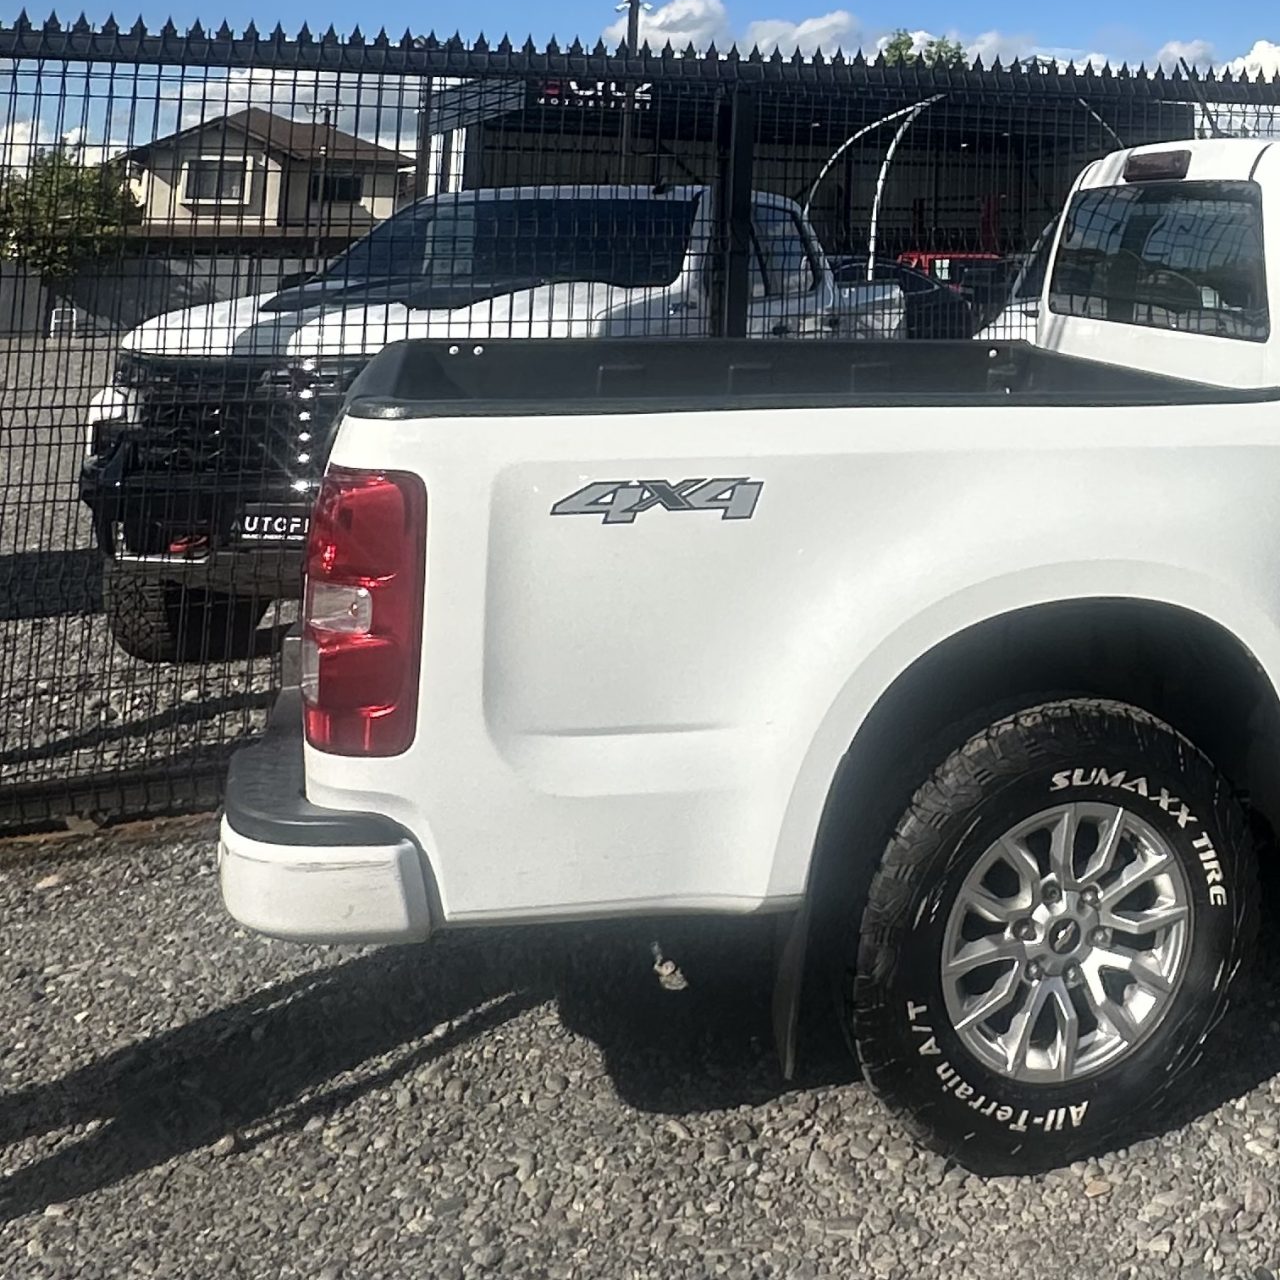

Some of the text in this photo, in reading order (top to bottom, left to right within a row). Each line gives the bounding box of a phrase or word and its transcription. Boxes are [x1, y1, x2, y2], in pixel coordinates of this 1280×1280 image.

[1050, 768, 1227, 906] SUMAXX TIRE
[907, 1001, 1089, 1132] All-Terrain A/T
